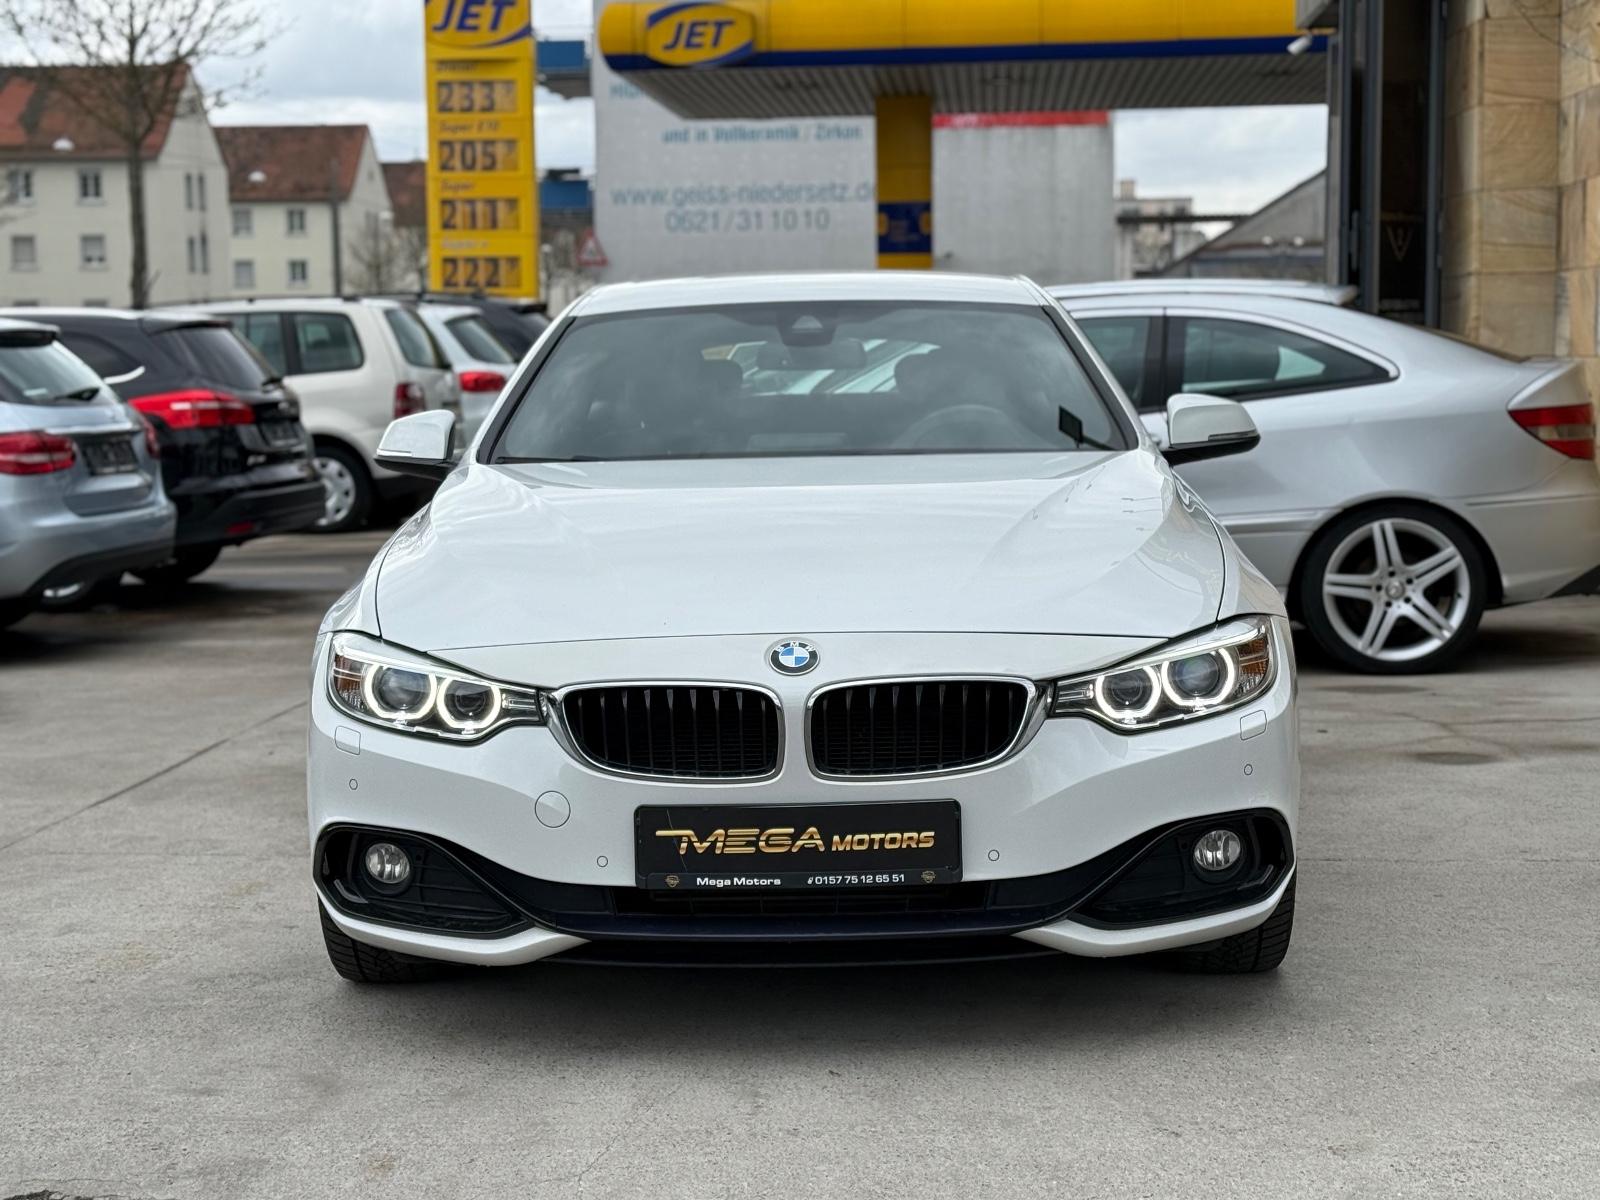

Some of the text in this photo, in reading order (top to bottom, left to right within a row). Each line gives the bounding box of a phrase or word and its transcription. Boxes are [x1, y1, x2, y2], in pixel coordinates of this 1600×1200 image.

[433, 0, 515, 32] JET
[663, 20, 735, 50] JET
[609, 181, 875, 207] www.geiss-niedersetz.d
[656, 827, 935, 855] MEGA MOTORS
[696, 873, 905, 888] Mega Motors 0157 75 12 65 51
